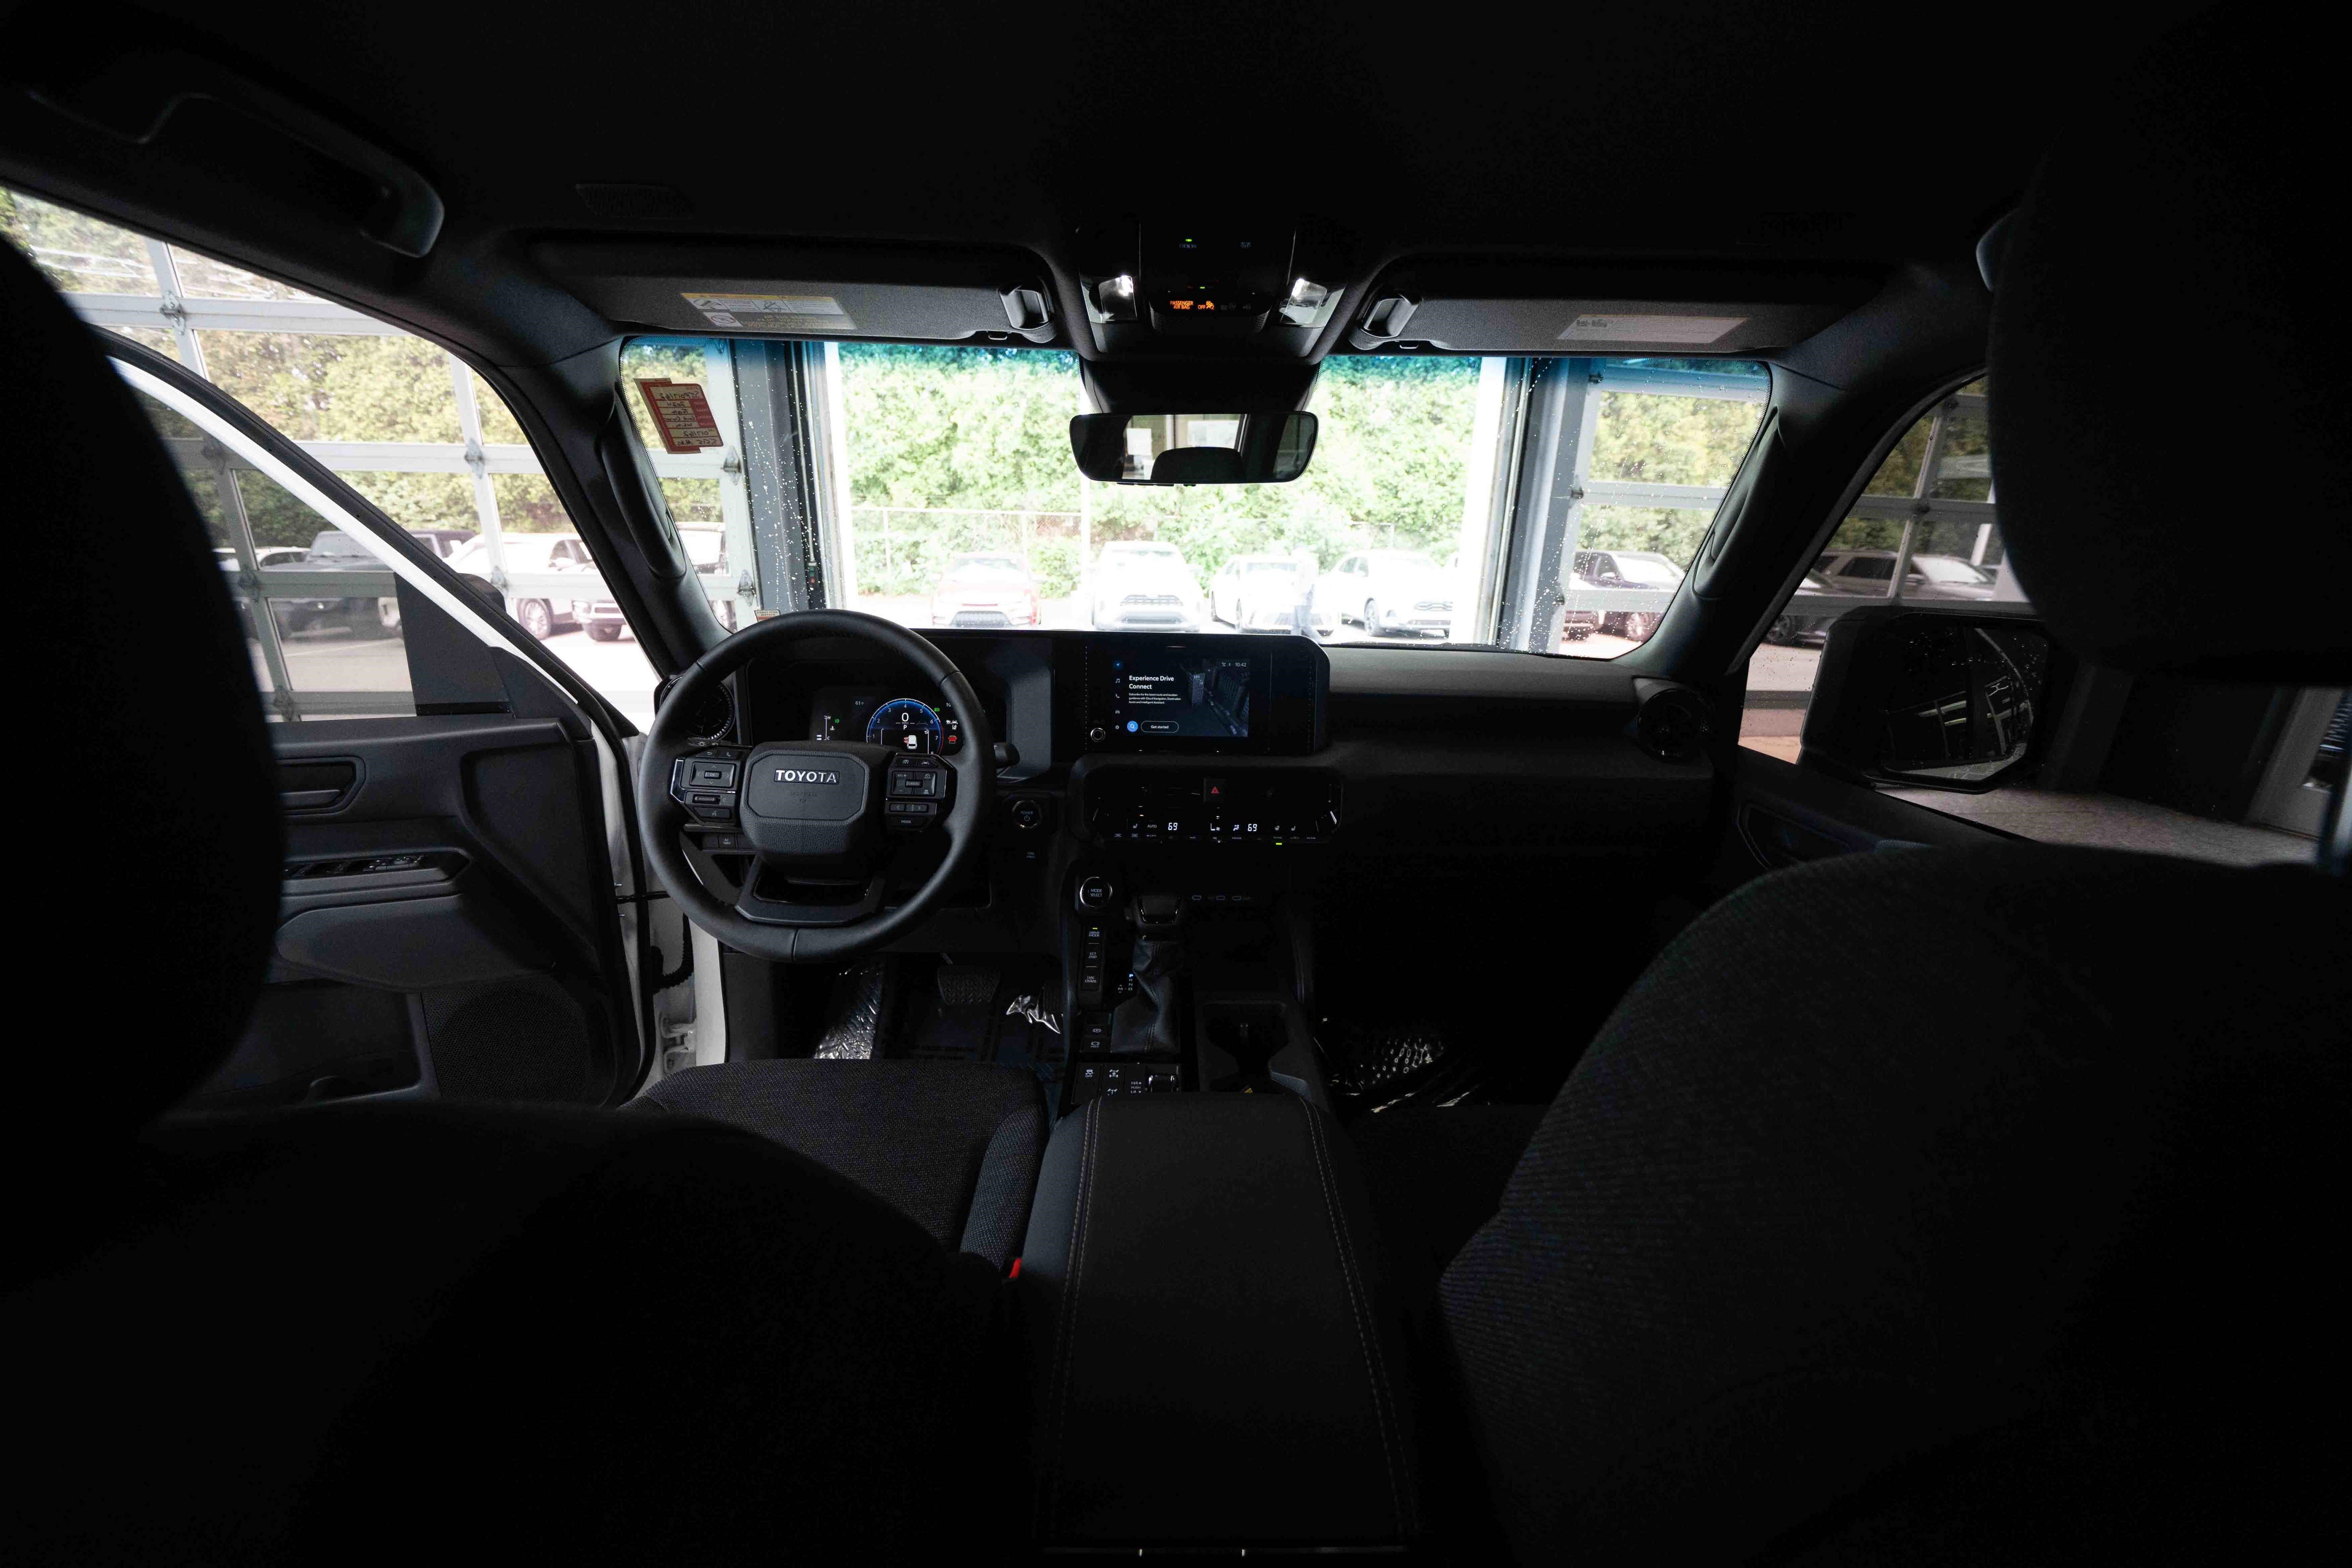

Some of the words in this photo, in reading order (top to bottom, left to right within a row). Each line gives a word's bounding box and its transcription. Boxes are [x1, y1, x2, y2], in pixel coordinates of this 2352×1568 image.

[902, 713, 909, 722] 0
[776, 770, 837, 783] TOYOTA
[1168, 822, 1178, 831] 69
[1247, 824, 1257, 832] 69
